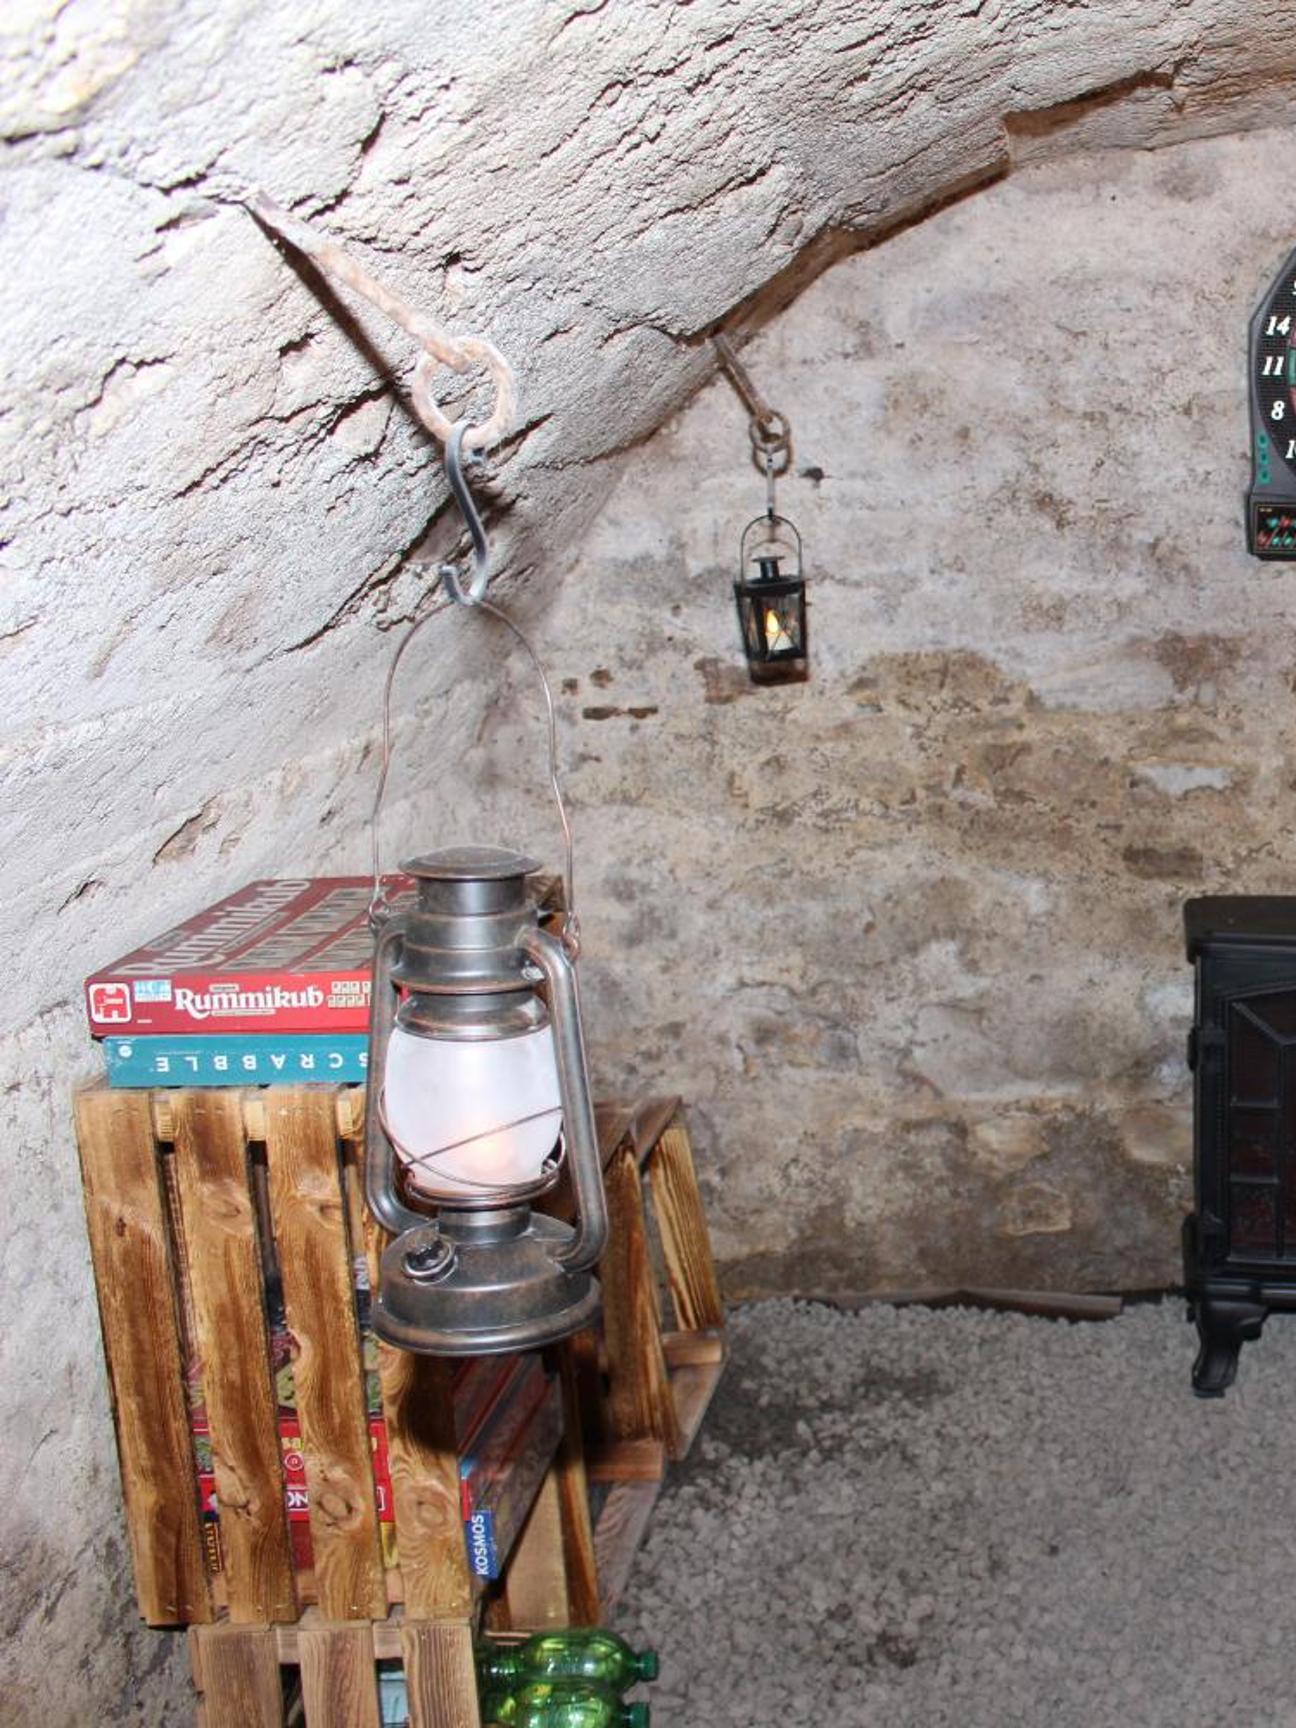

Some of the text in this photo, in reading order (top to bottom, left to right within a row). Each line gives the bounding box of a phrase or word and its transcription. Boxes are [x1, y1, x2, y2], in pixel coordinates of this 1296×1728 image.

[1266, 315, 1291, 336] 14
[1262, 356, 1285, 376] 11
[1271, 400, 1285, 420] 8
[108, 880, 310, 976] Rummikub
[174, 984, 323, 1019] Rummikub
[154, 1052, 369, 1073] SCRABBLE
[471, 1513, 489, 1576] KOSMOS
